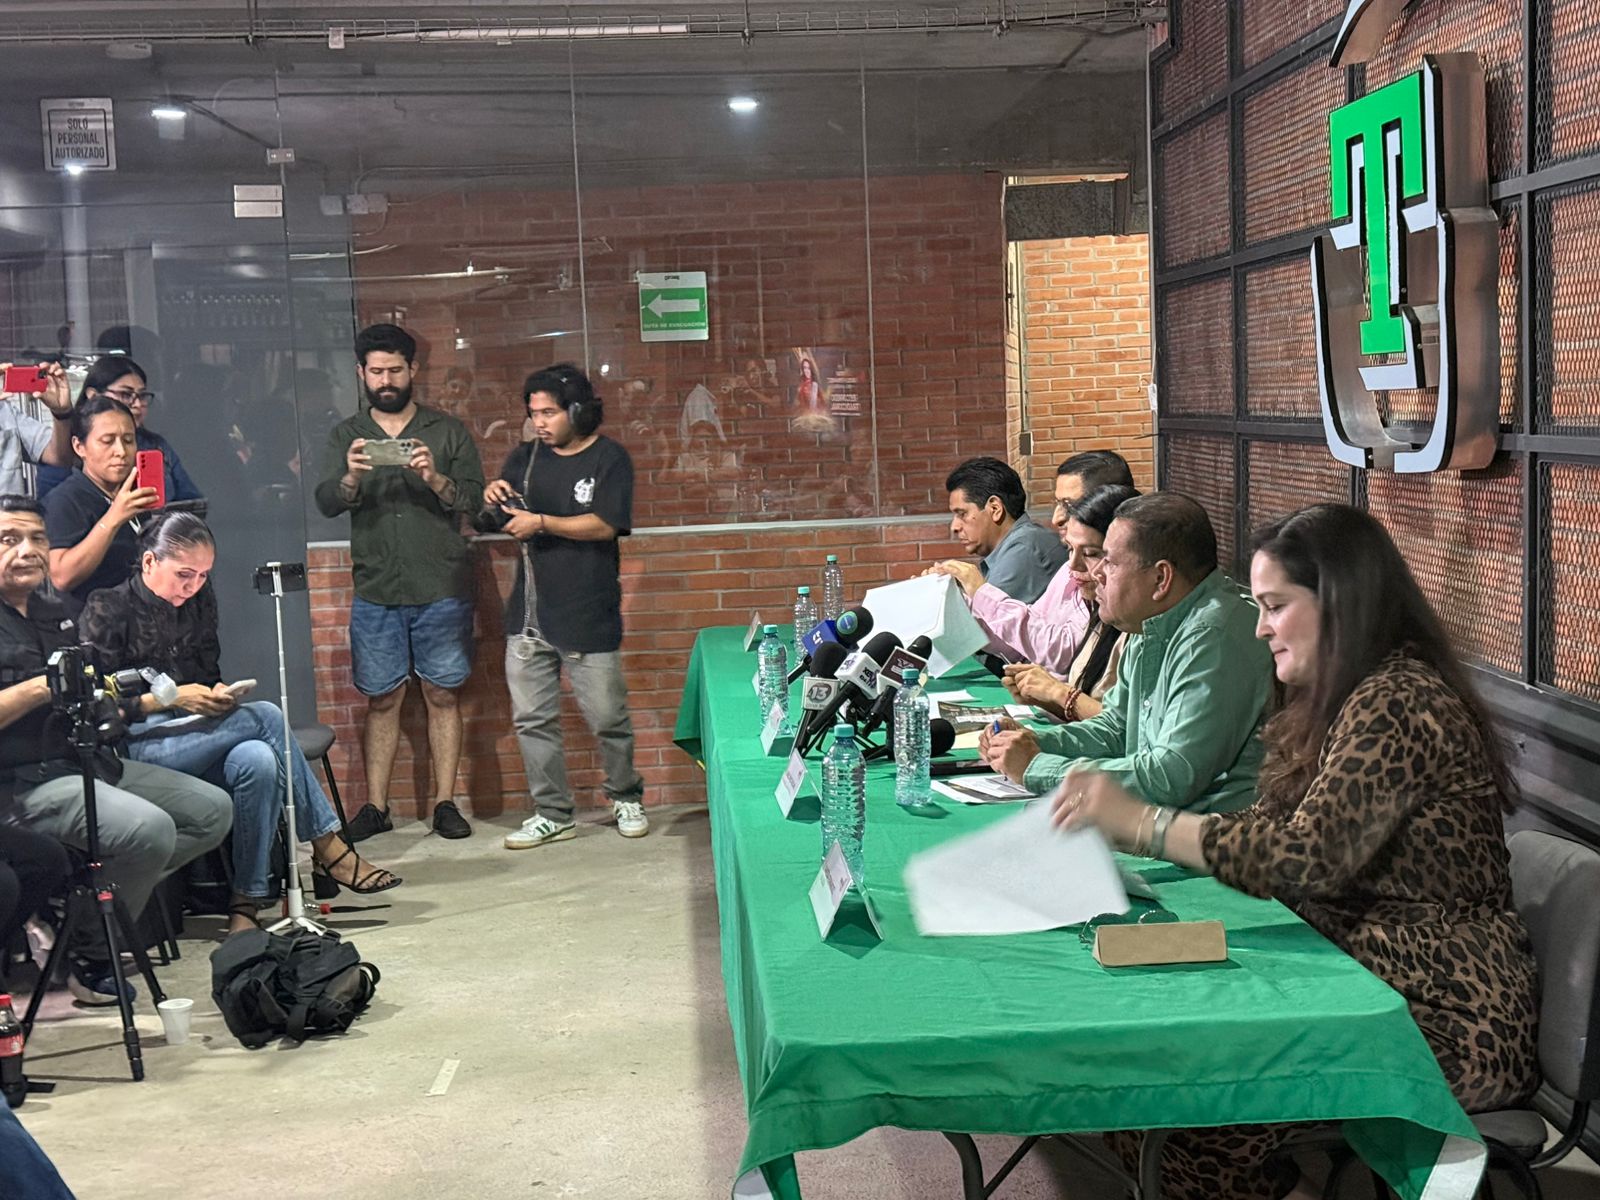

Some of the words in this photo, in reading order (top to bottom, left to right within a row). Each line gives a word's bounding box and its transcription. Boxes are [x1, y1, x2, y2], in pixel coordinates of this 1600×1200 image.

[67, 117, 88, 130] SOLO
[58, 132, 99, 145] PERSONAL
[55, 147, 105, 159] AUTORIZADO
